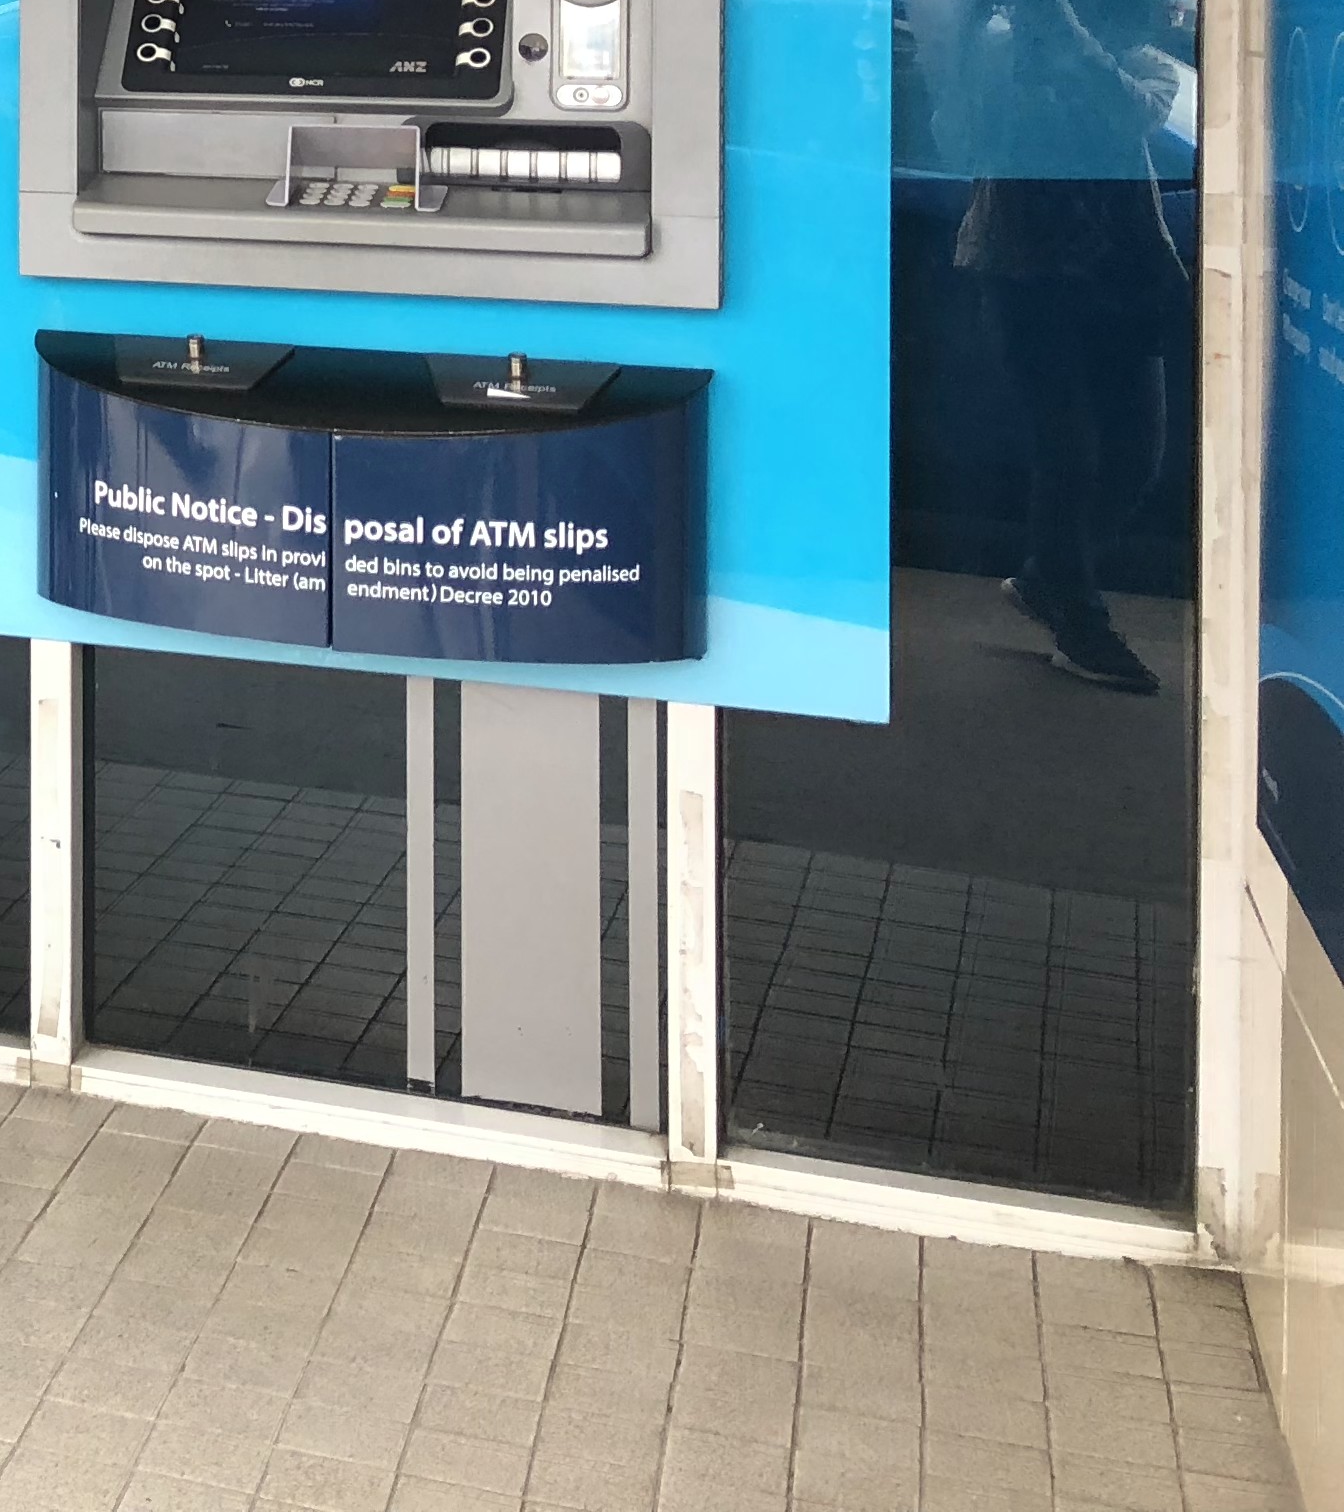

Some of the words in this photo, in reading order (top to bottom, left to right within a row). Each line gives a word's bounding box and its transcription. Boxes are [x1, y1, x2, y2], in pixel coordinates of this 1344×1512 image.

[306, 78, 324, 87] NCR
[389, 61, 427, 73] ANZ
[94, 480, 165, 515] Public
[171, 492, 258, 527] Notice
[282, 505, 327, 534] Dis
[344, 516, 424, 544] posal
[431, 518, 464, 545] of
[469, 521, 535, 548] ATM
[543, 521, 608, 555] slips
[79, 517, 121, 539] Please
[124, 526, 179, 551] dispose
[183, 535, 217, 556] ATM
[222, 540, 257, 561] slips
[262, 545, 277, 562] in
[282, 549, 326, 569] provi
[345, 555, 378, 574] ded
[383, 557, 420, 578] bins
[425, 562, 444, 577] to
[448, 563, 497, 581] avoid
[503, 565, 554, 586] being
[559, 565, 640, 586] penalised
[143, 554, 162, 570] on
[166, 557, 191, 574] the
[195, 563, 231, 581] spot
[245, 568, 289, 589] Litter
[293, 571, 325, 592] (am
[347, 580, 437, 602] endment)
[440, 586, 503, 606] Decree
[507, 589, 552, 607] 2010
